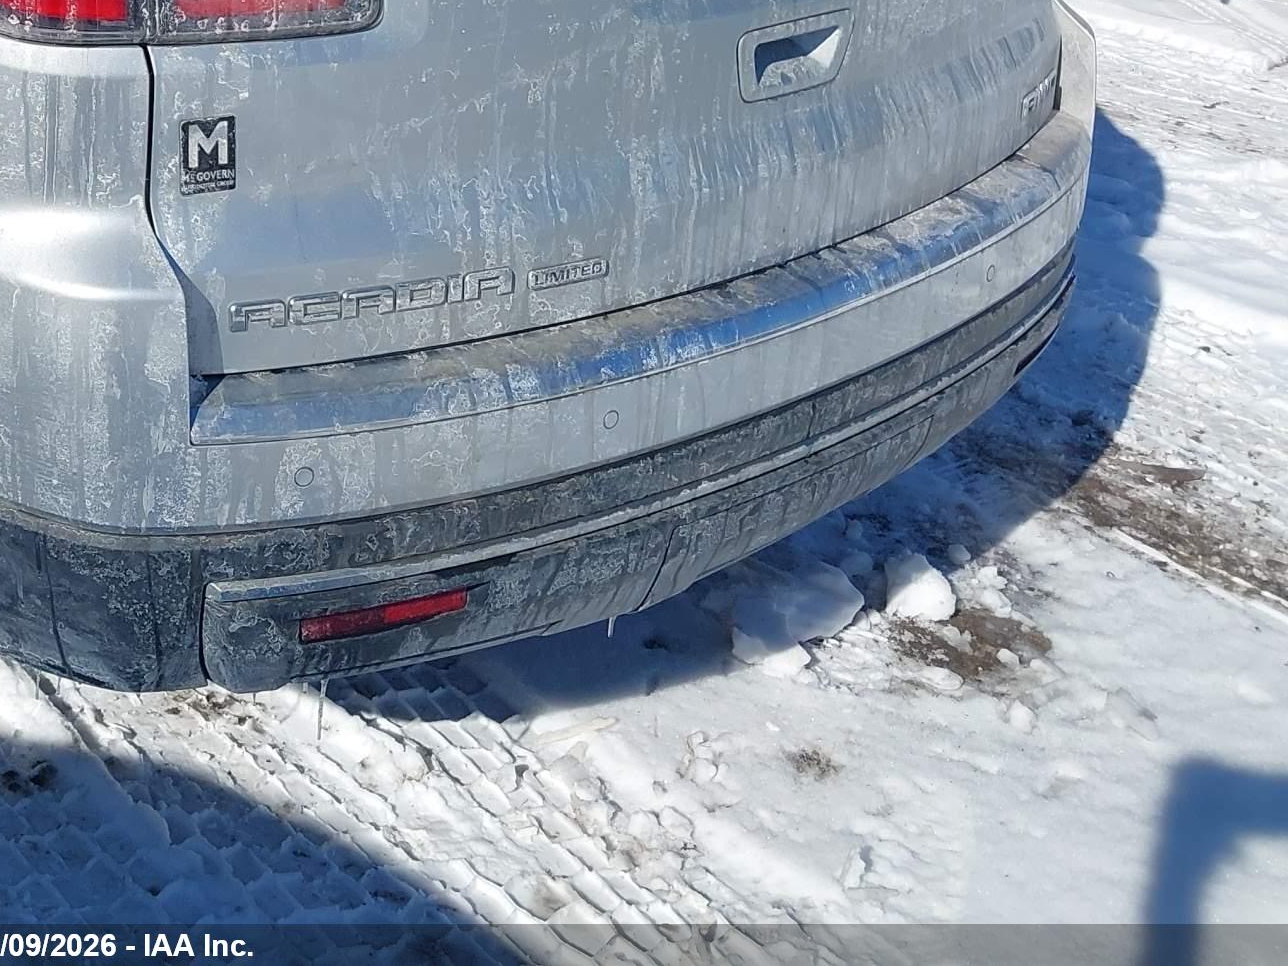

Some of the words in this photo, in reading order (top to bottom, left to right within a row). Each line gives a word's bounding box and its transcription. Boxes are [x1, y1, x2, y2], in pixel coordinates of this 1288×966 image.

[188, 120, 228, 168] M
[229, 266, 515, 332] ACADIA
[533, 260, 605, 286] LIMITED
